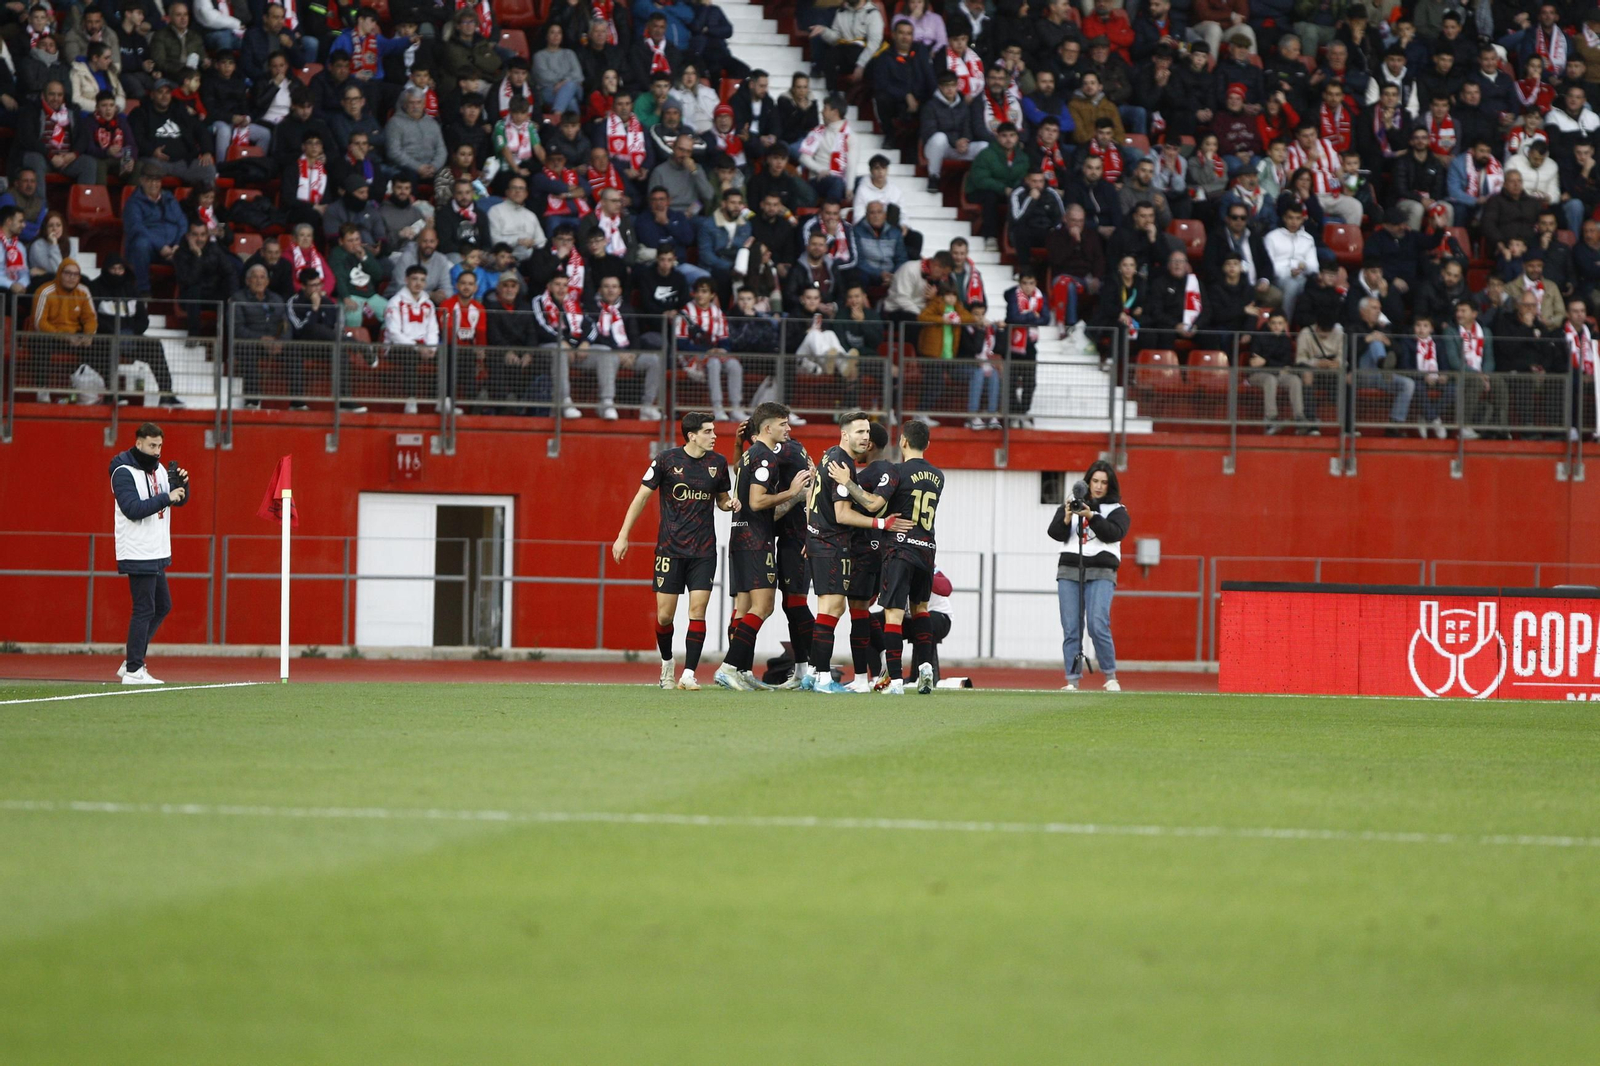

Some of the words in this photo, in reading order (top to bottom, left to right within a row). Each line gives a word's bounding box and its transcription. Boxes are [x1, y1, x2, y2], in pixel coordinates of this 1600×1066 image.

[910, 471, 942, 488] MONTIEL
[910, 489, 937, 531] 15
[655, 556, 671, 573] 26
[765, 552, 774, 568] 4
